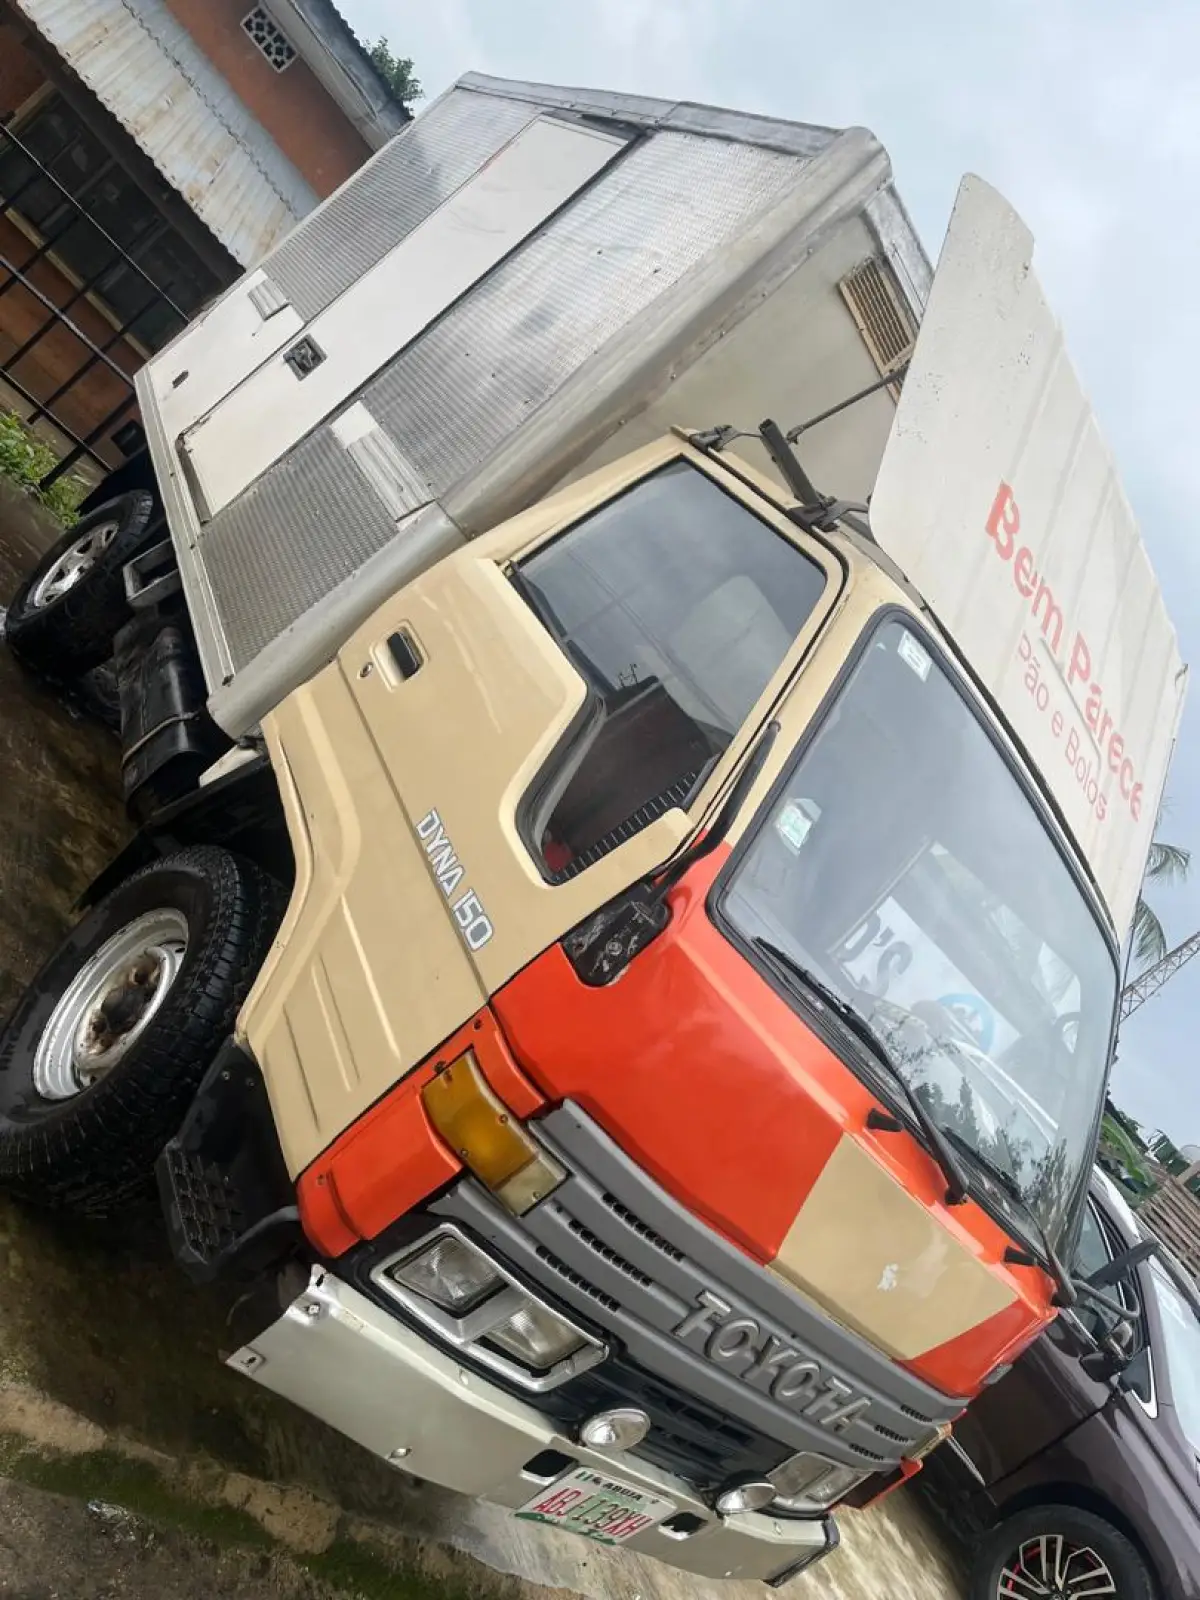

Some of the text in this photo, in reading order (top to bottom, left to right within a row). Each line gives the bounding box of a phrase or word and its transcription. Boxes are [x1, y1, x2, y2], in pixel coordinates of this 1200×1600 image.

[985, 481, 1144, 823] Bem Parece
[1051, 710, 1063, 738] e
[1065, 726, 1108, 821] Bolos
[416, 807, 494, 952] DYNA 150
[670, 1288, 873, 1432] TOYOTA
